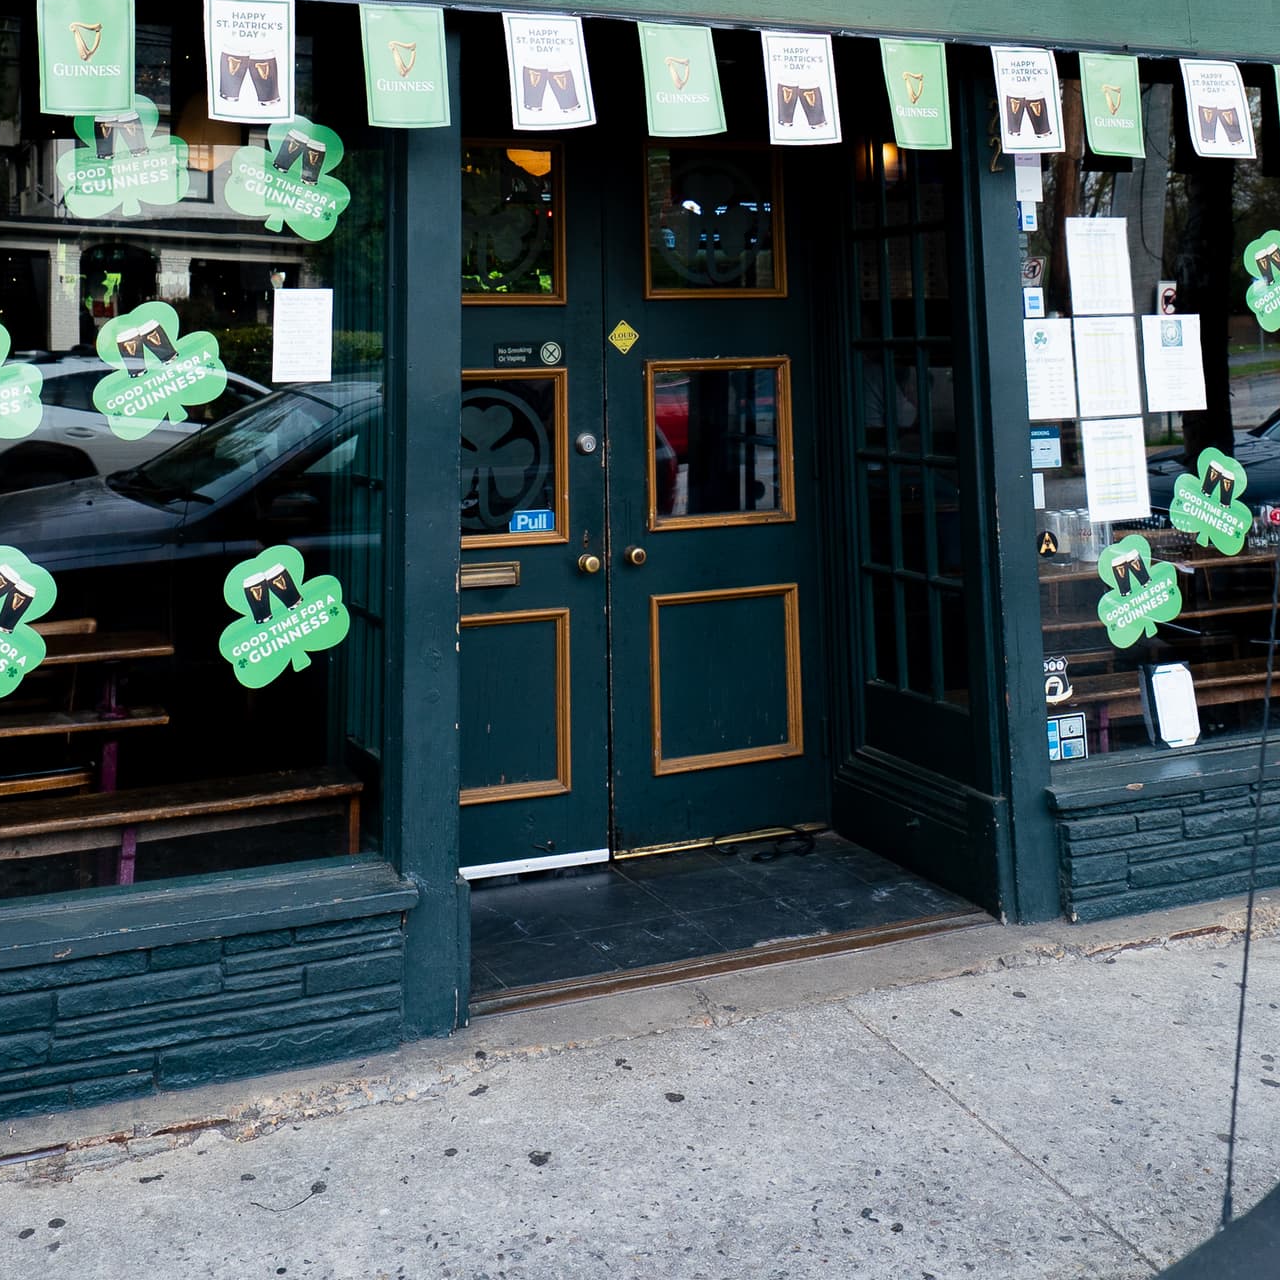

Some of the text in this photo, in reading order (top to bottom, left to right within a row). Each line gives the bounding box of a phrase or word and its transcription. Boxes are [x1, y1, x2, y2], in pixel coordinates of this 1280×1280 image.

[232, 12, 266, 20] HAPPY
[233, 21, 282, 30] PATRICK'S
[52, 63, 120, 77] GUINNESS
[377, 79, 433, 92] GUINNESS
[656, 91, 709, 104] GUINNESS
[896, 105, 937, 117] GUINNESS
[1095, 117, 1134, 129] GUINNESS
[990, 136, 1005, 172] 2
[68, 156, 180, 181] GOOD TIME FOR A
[82, 169, 170, 193] GUINNESS
[239, 164, 336, 209] GOOD TIME FOR A
[245, 179, 322, 217] GUINNESS
[1255, 292, 1274, 308] GOOD
[508, 347, 532, 355] Smoking
[24, 385, 33, 394] A
[107, 350, 212, 409] GOOD TIME FOR A
[124, 367, 206, 416] GUINNESS
[1178, 489, 1237, 525] GOOD TIME FOR
[1183, 502, 1234, 535] GUINNESS
[517, 513, 547, 530] Pull
[1107, 578, 1173, 621] GOOD TIME FOR A
[1118, 591, 1169, 628] GUINNESS
[233, 594, 336, 656] GOOD TIME FOR A
[249, 611, 330, 663] GUINNESS
[16, 656, 26, 667] A
